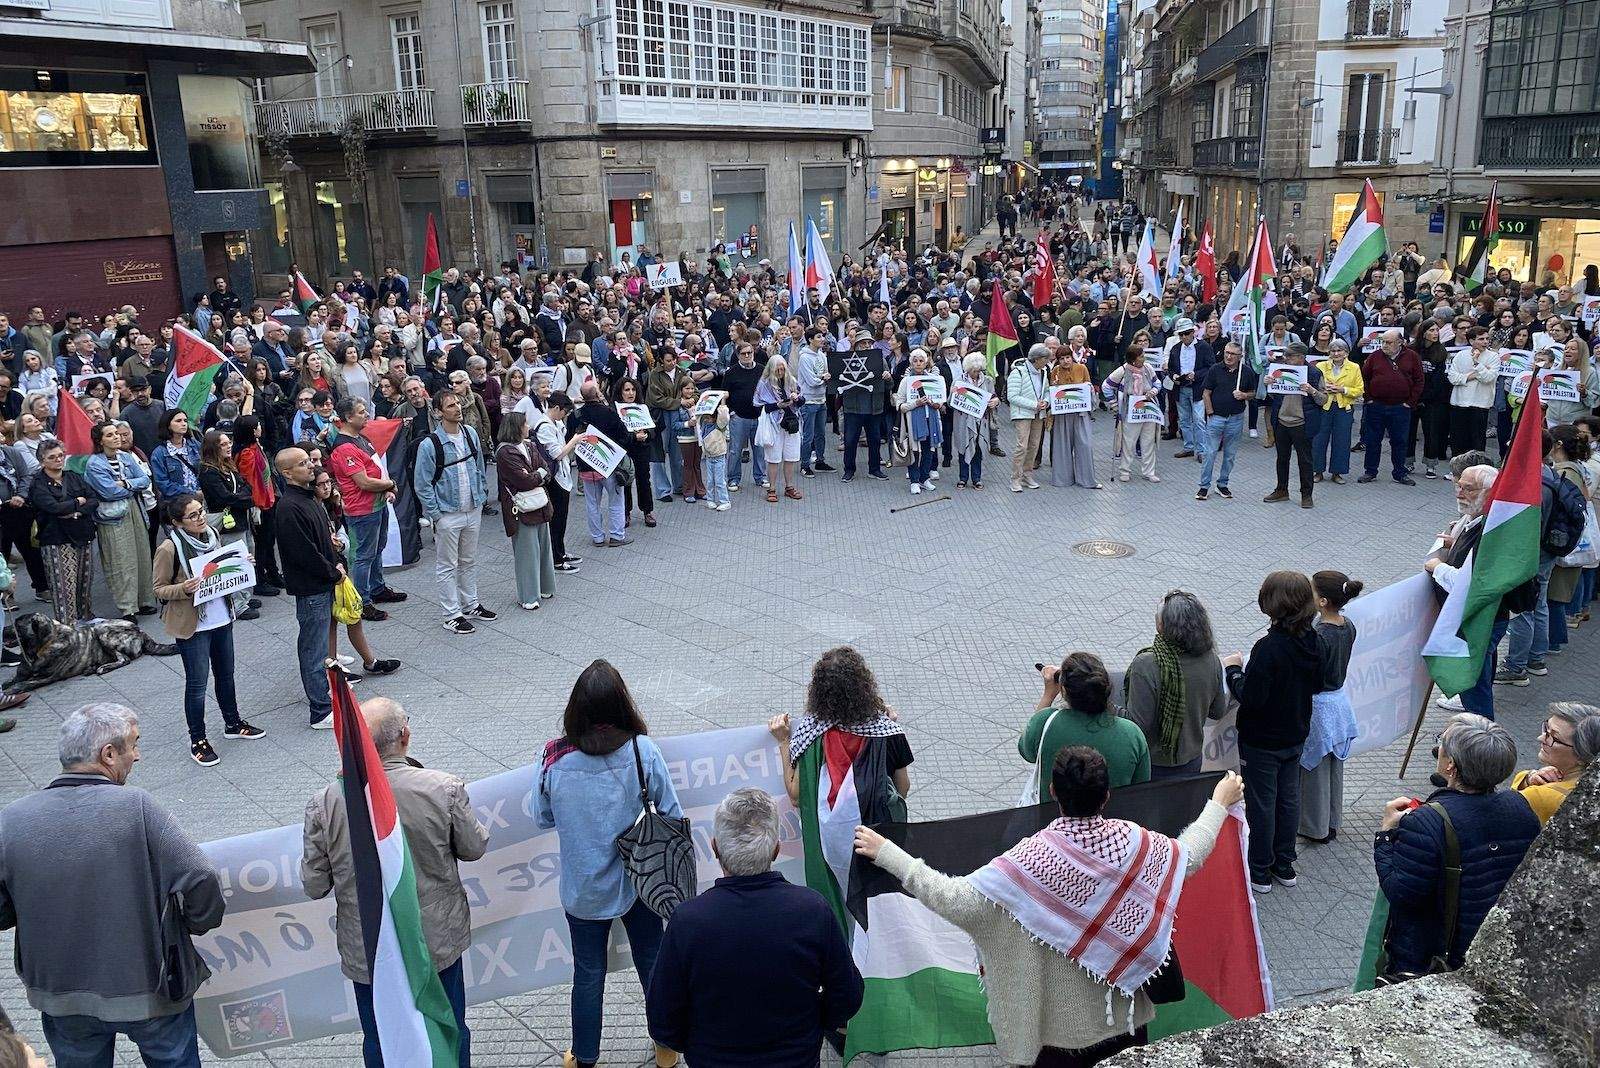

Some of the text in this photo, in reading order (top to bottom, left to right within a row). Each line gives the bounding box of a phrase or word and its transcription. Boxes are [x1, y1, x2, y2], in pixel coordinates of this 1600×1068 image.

[1553, 391, 1576, 399] PALESTINA
[1064, 402, 1087, 410] PALESTINA
[199, 573, 249, 599] CON PALESTINA
[200, 574, 222, 590] GALIZA
